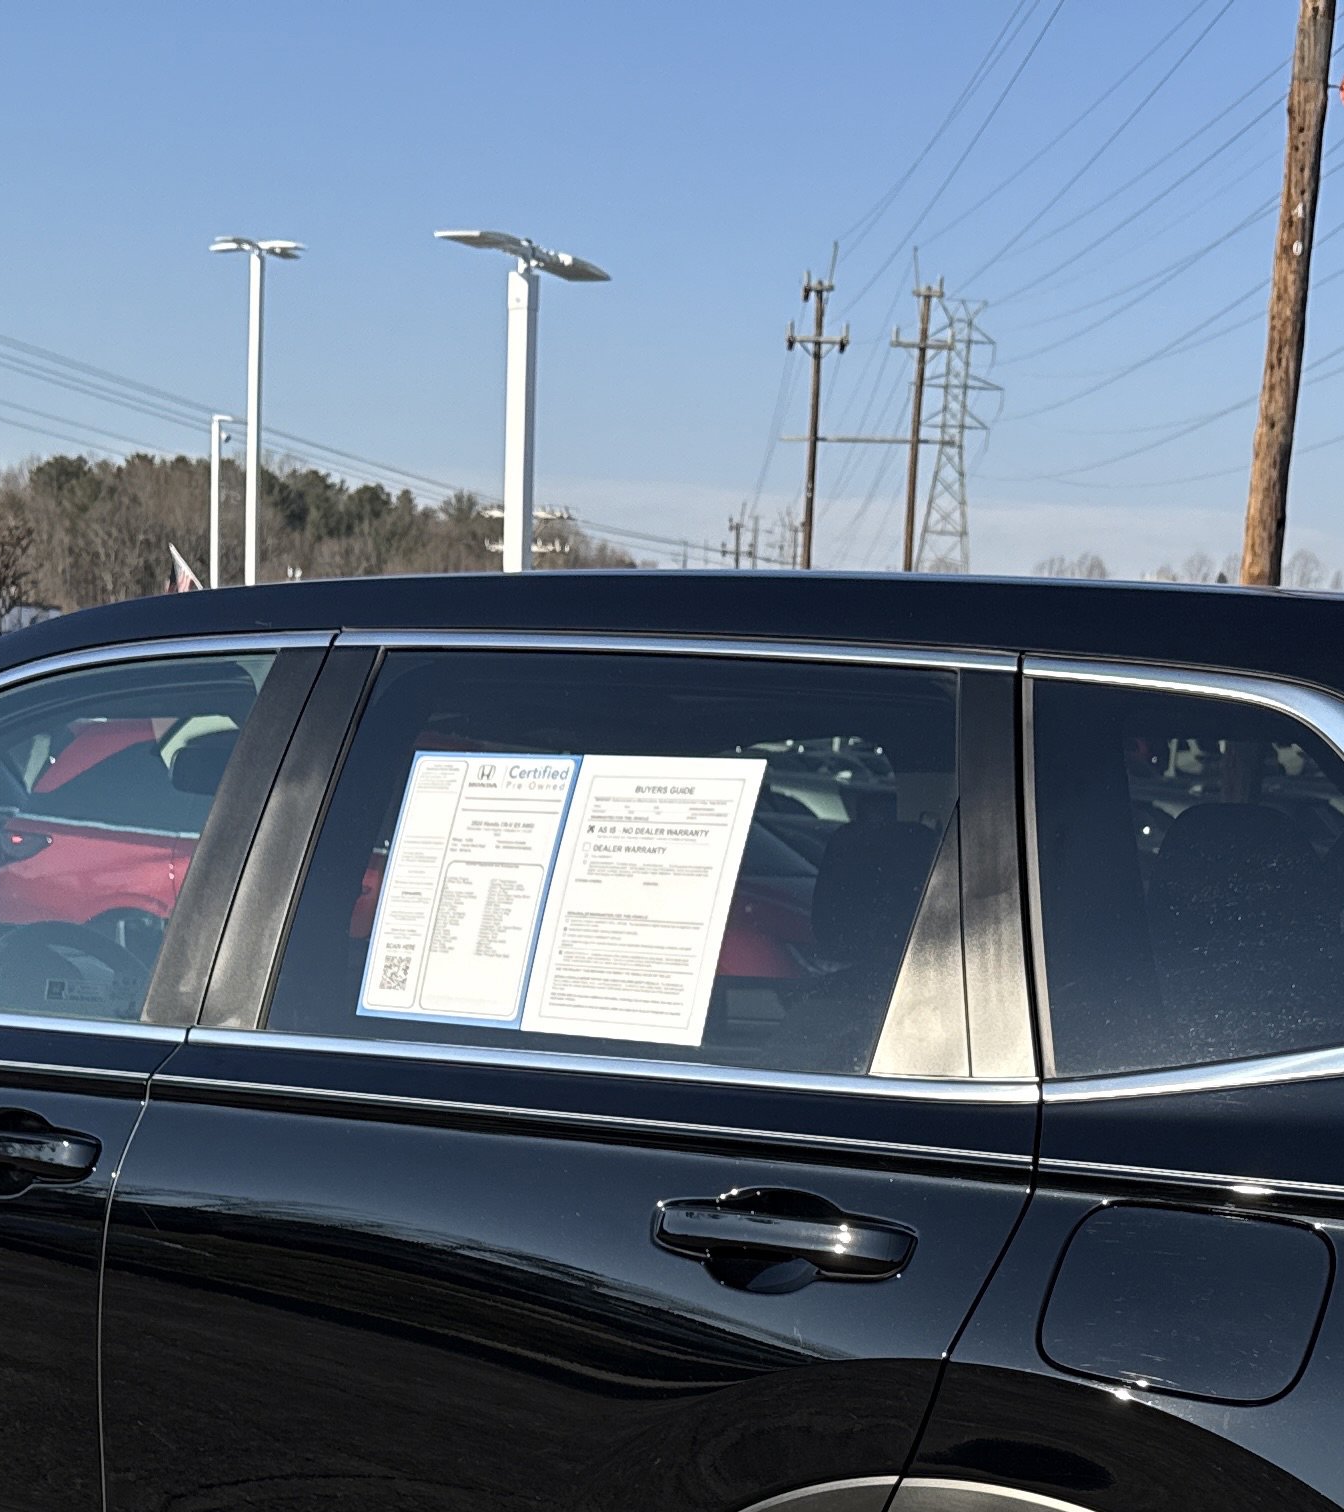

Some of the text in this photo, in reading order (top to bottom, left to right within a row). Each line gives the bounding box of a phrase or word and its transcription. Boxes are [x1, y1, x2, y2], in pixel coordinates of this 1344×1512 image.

[508, 764, 571, 781] Certified
[505, 780, 566, 791] Pre Owned
[634, 785, 696, 796] BUYERS GUIDE
[597, 825, 608, 834] AS
[622, 826, 634, 835] NO
[634, 827, 665, 837] DEALER
[666, 828, 710, 838] WARRANTY
[592, 844, 667, 855] DEALER WARRANTY
